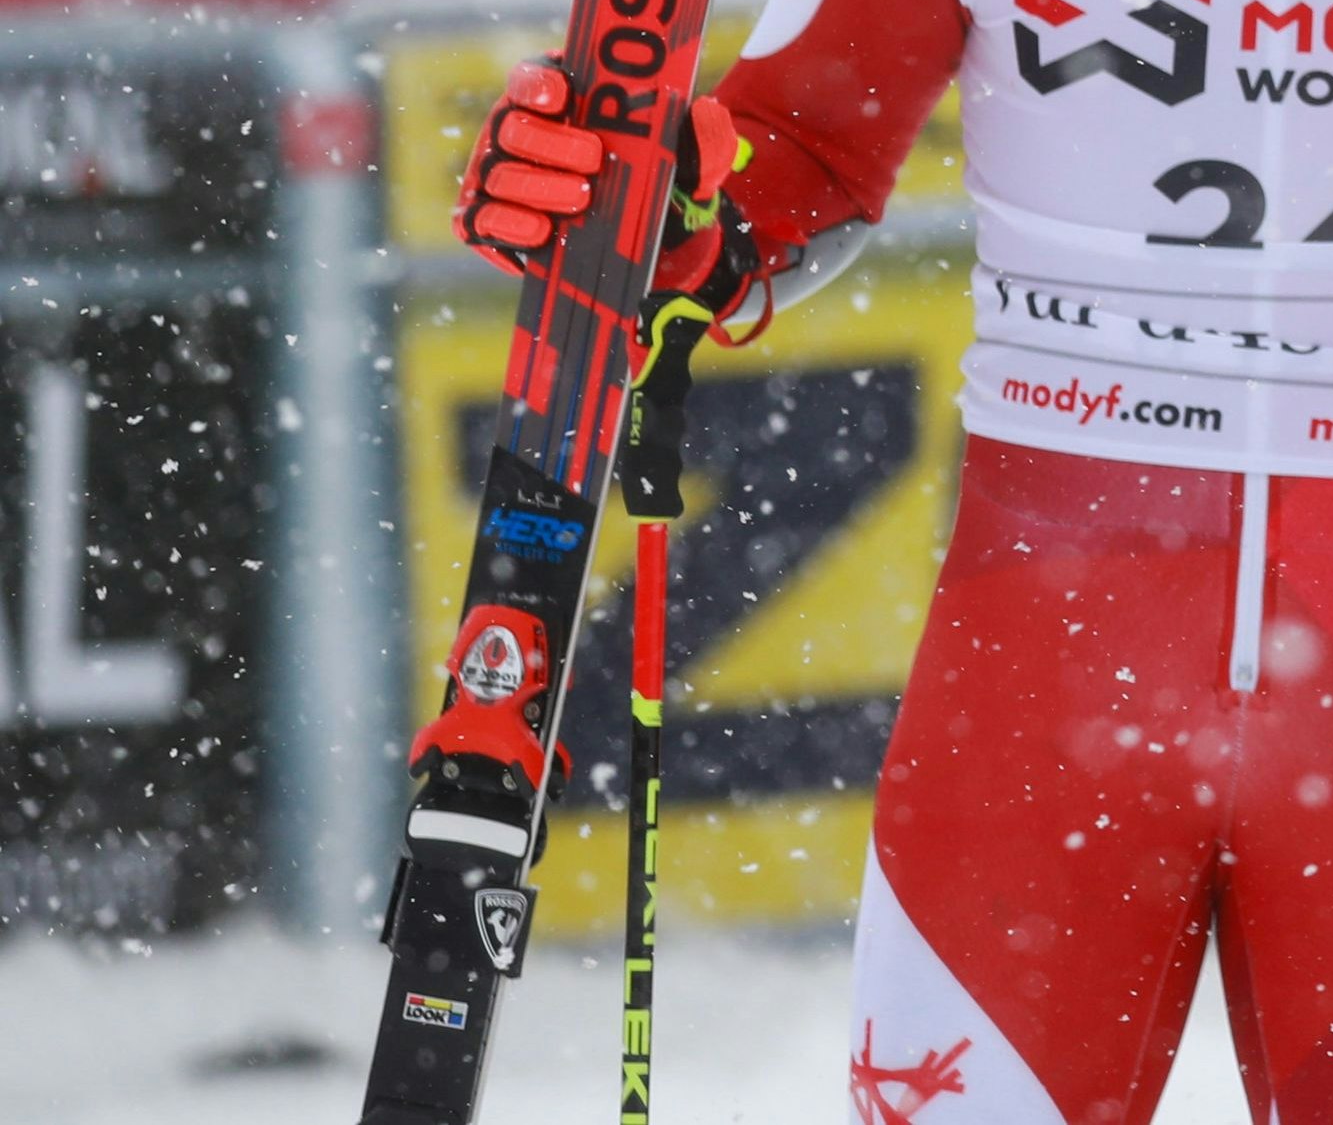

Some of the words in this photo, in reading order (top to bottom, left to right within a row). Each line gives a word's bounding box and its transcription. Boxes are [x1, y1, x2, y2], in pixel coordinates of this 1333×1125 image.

[1002, 375, 1223, 433] modyf.com
[482, 506, 586, 552] HERO
[405, 1005, 449, 1026] LOOK
[621, 956, 652, 1125] LEKI
